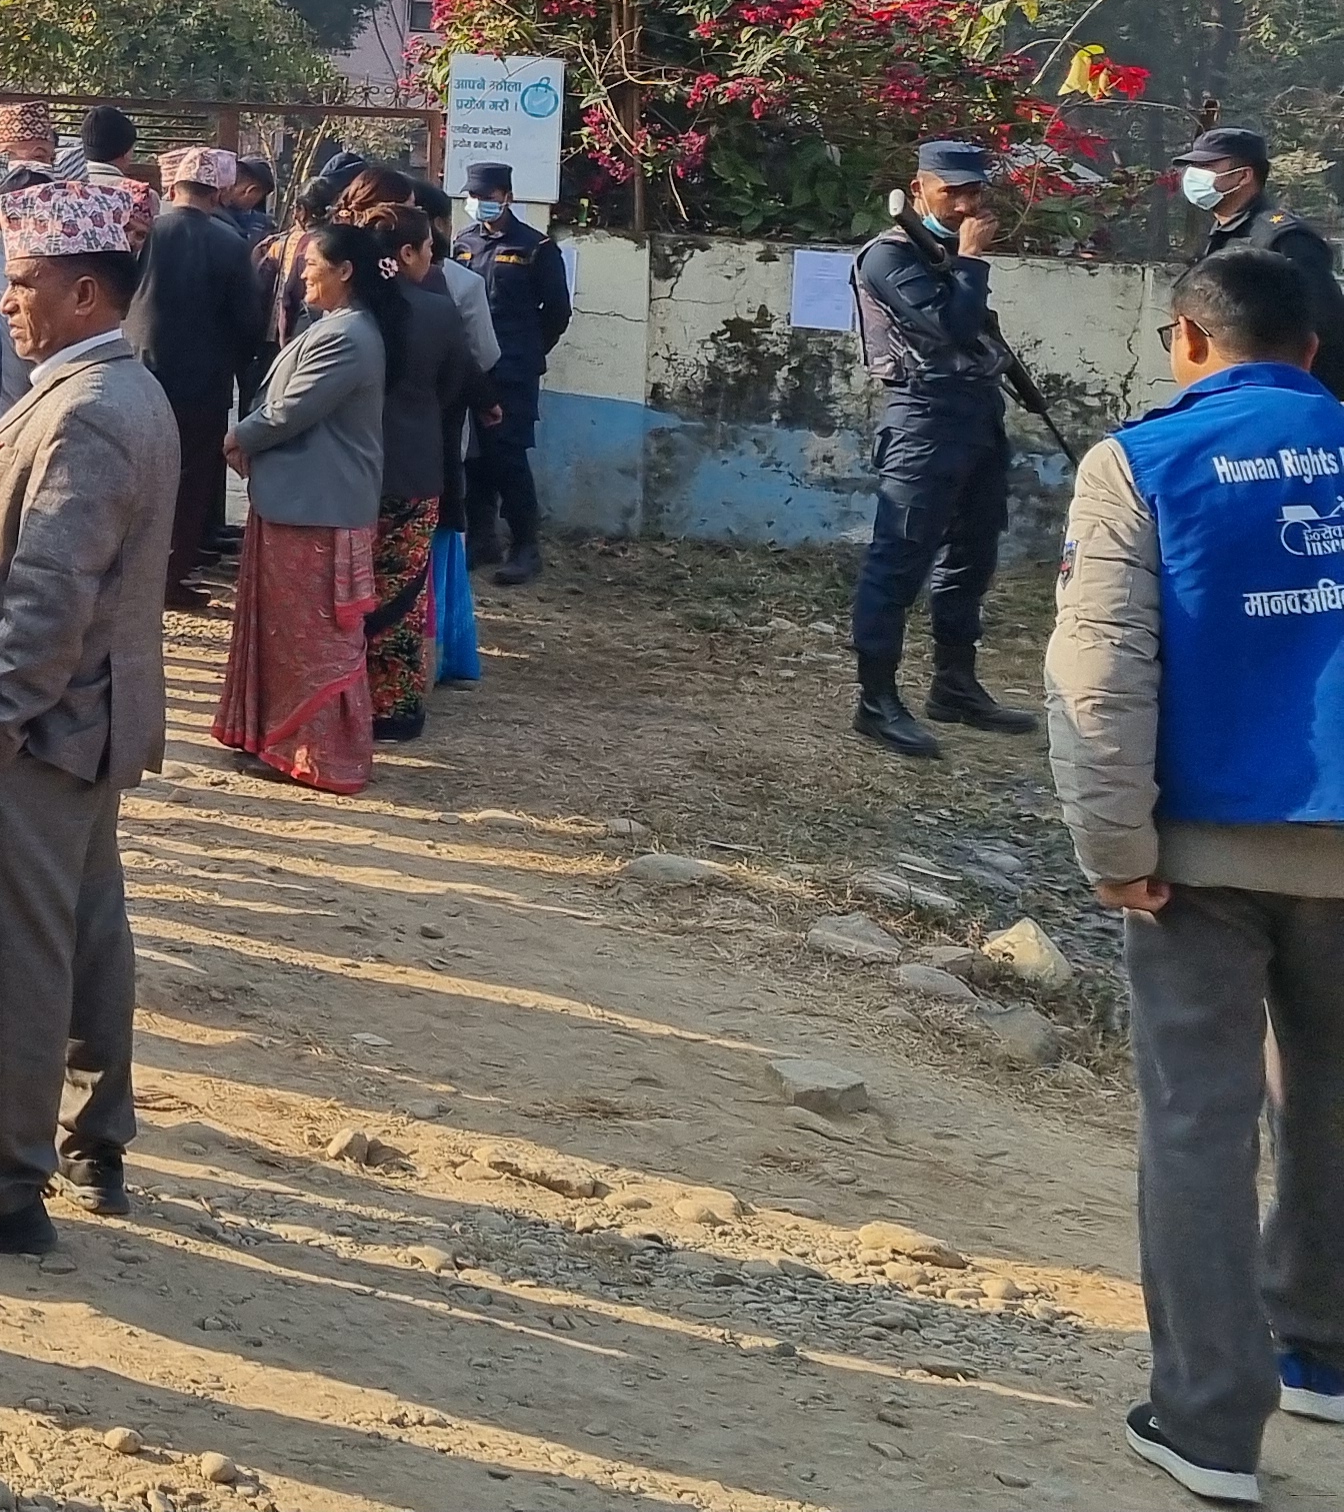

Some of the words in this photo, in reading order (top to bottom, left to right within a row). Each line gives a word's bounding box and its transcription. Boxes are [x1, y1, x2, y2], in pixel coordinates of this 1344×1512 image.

[1212, 455, 1281, 484] Human
[1278, 447, 1340, 484] Rights
[1243, 578, 1344, 617] मानवअधि
